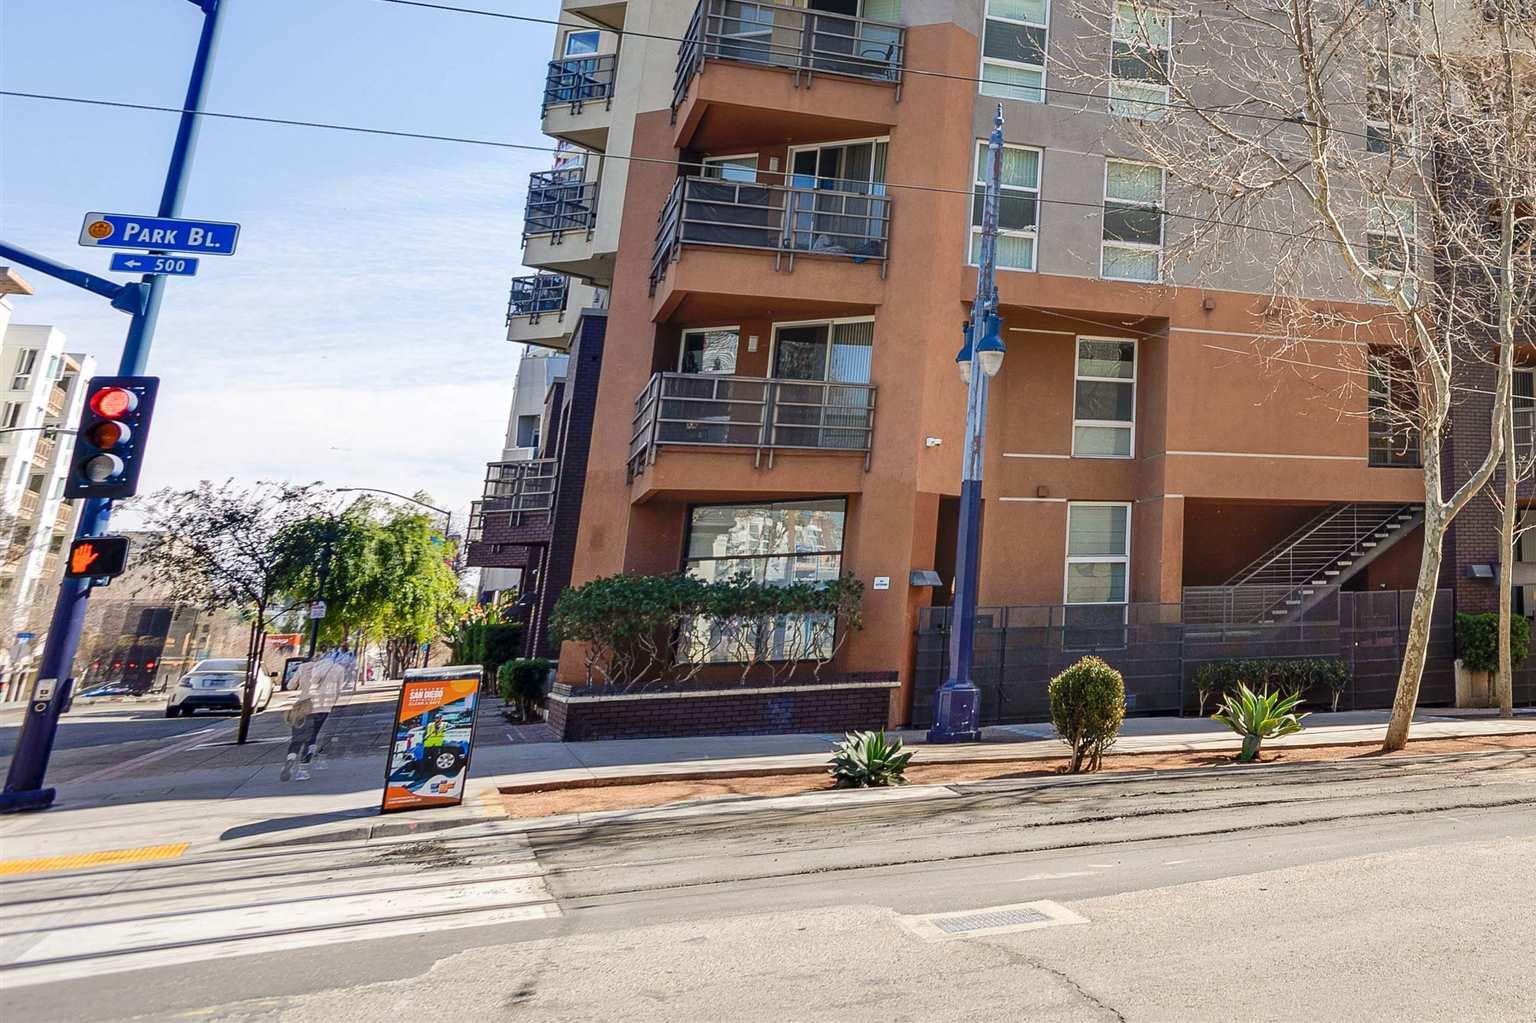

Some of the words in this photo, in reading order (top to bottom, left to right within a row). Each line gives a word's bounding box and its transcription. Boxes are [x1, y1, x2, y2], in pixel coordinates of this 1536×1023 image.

[123, 222, 178, 244] PARK
[187, 227, 221, 248] BL.
[154, 258, 185, 272] 500
